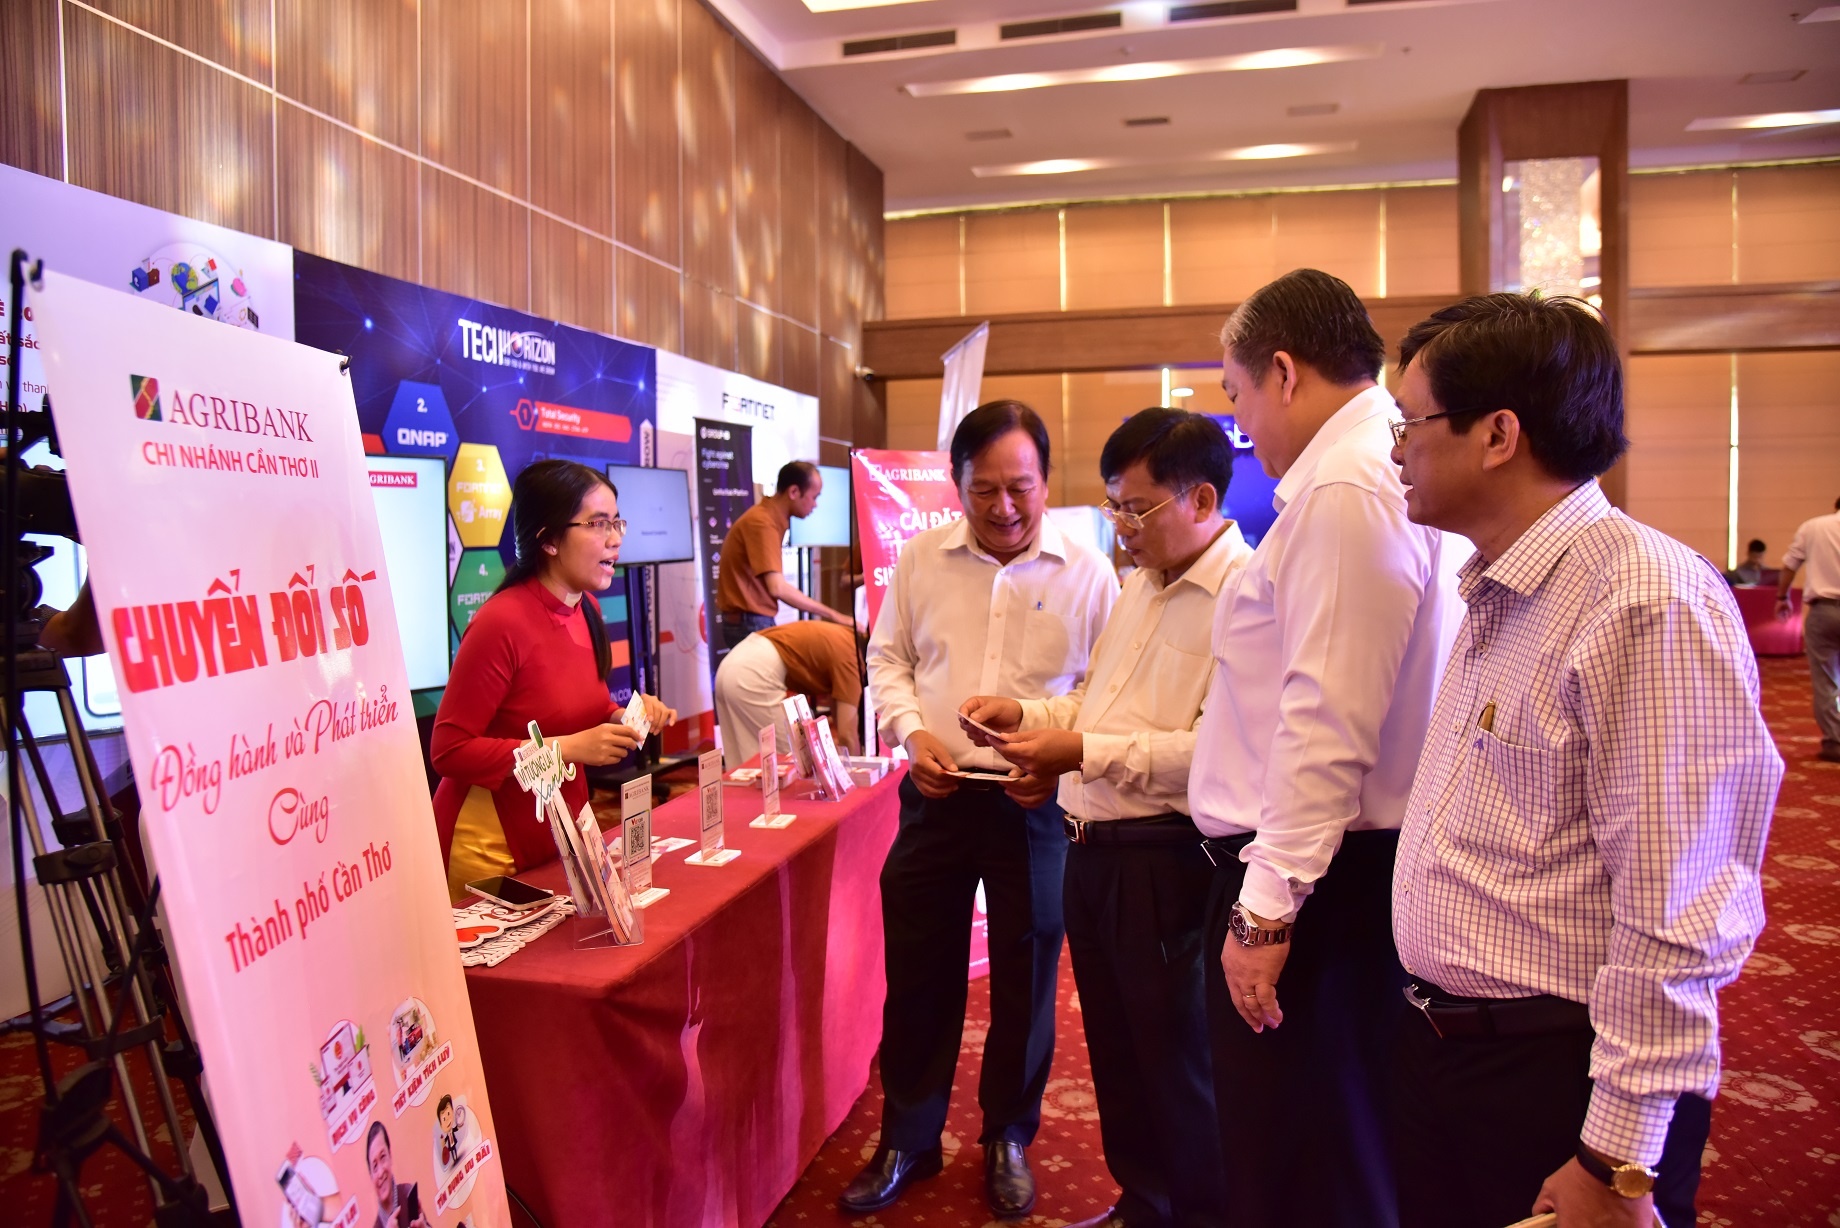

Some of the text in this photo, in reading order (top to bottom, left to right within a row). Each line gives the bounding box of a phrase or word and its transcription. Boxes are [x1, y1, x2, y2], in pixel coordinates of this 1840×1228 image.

[416, 398, 428, 412] 2.
[169, 390, 313, 443] AGRIBANK
[397, 428, 446, 448] QNAP
[142, 441, 319, 479] CHI NHÁNH CẦN THƠ II
[476, 459, 486, 472] 3.
[370, 473, 415, 485] GRIBANK
[884, 468, 947, 482] AGRIBANK
[478, 505, 503, 520] Array
[899, 507, 928, 531] CÀI
[478, 564, 488, 576] 4.
[111, 564, 377, 694] CHUYỂN ĐỔI SỐ
[150, 684, 399, 815] Đồng hành và Phát triển
[268, 787, 329, 846] Cùng
[225, 841, 393, 974] Thành phố Cần Thơ
[423, 1059, 437, 1080] TÍCH
